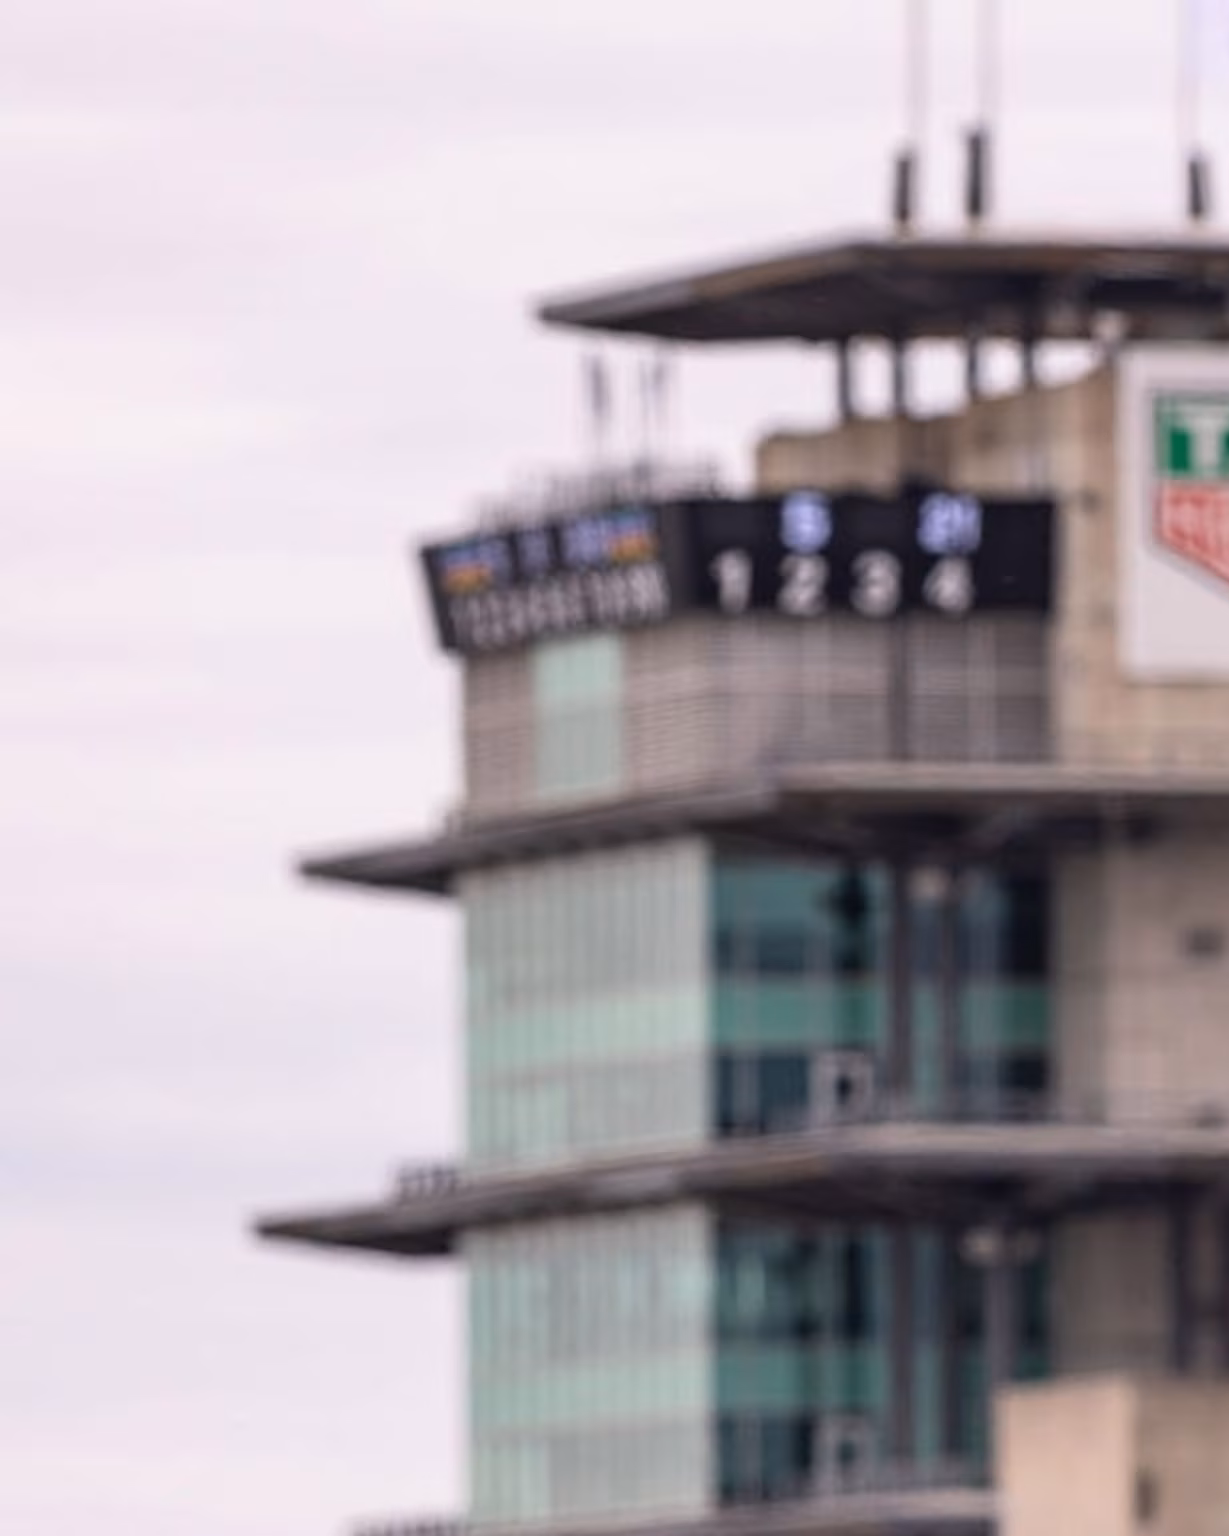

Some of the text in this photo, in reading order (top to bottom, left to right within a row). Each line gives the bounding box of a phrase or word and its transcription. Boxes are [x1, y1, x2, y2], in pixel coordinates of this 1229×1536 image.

[714, 549, 752, 613] 1
[779, 553, 827, 614] 2
[852, 551, 898, 615] 3
[924, 557, 973, 613] 4
